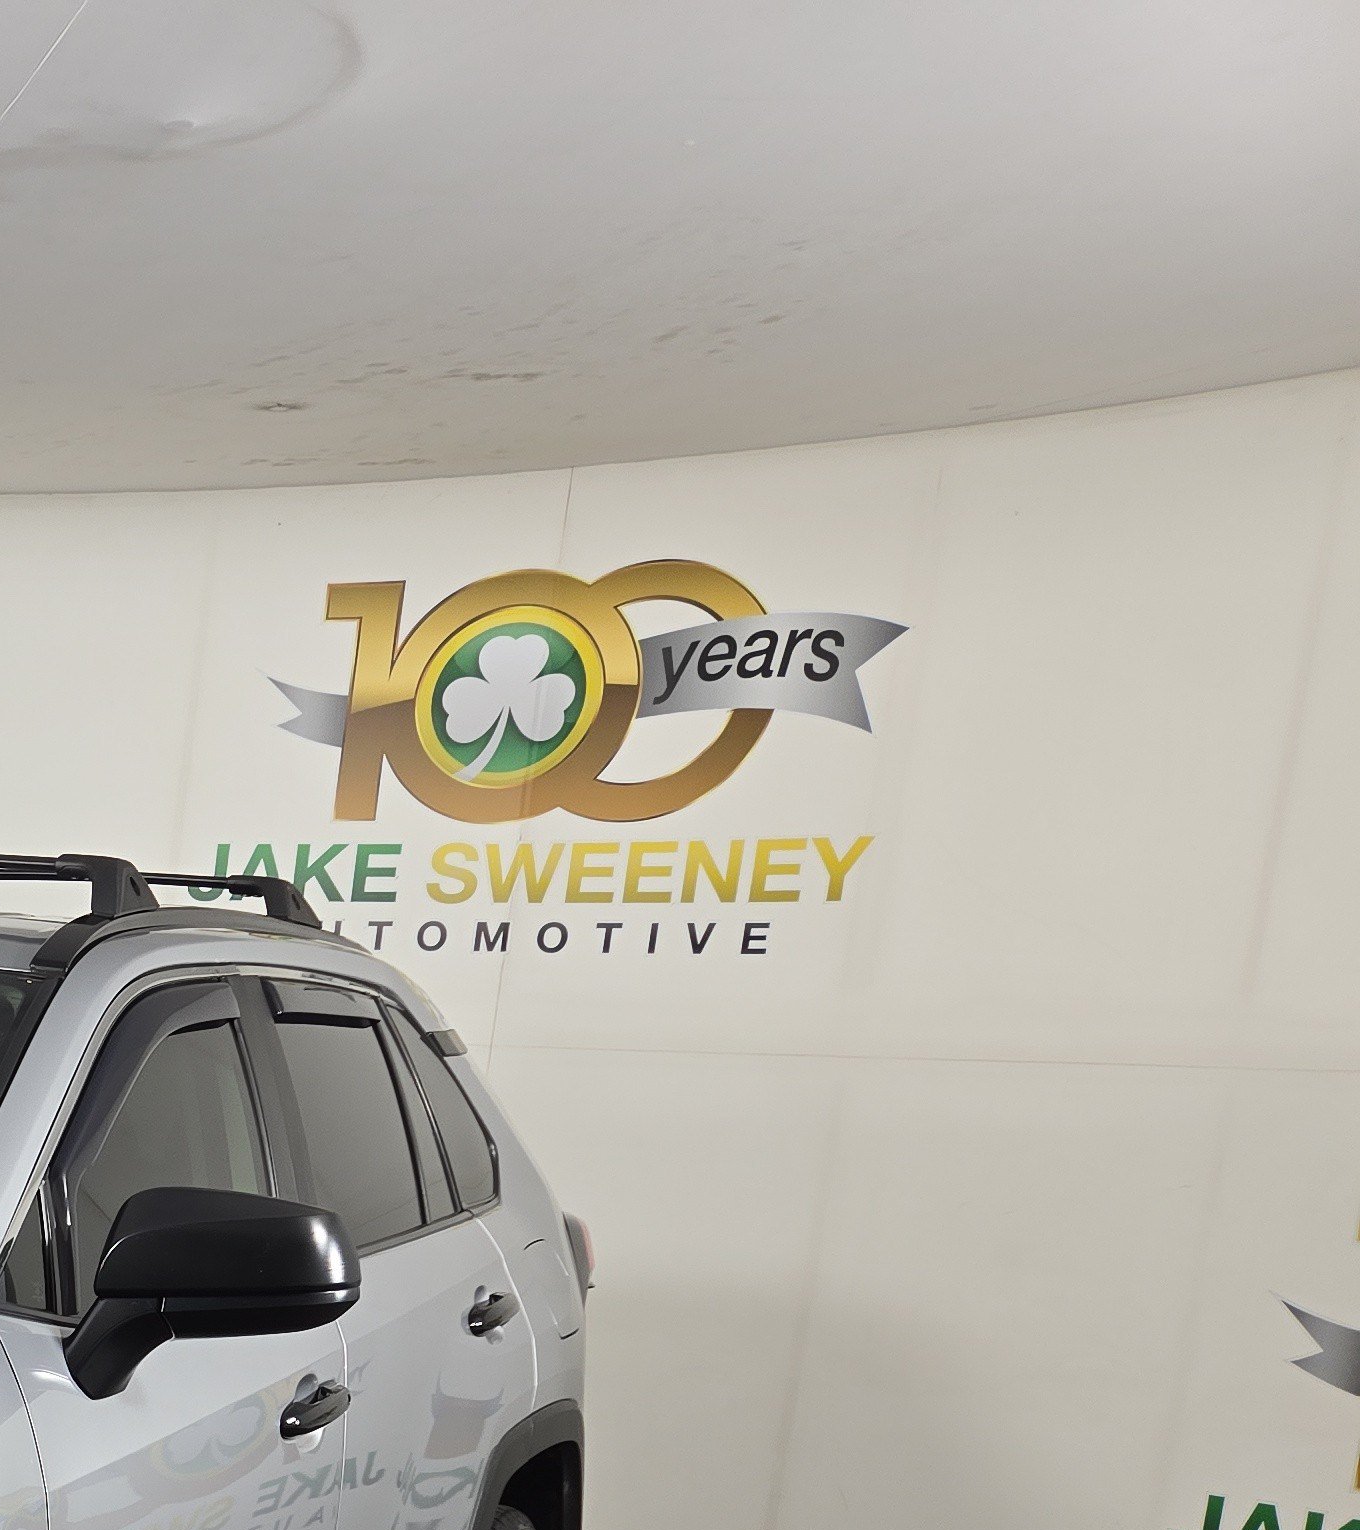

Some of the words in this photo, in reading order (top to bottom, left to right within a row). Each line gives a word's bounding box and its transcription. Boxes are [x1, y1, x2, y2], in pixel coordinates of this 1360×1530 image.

[653, 626, 845, 706] years
[427, 835, 874, 905] SWEENEY
[321, 920, 772, 956] TOMOTIVE
